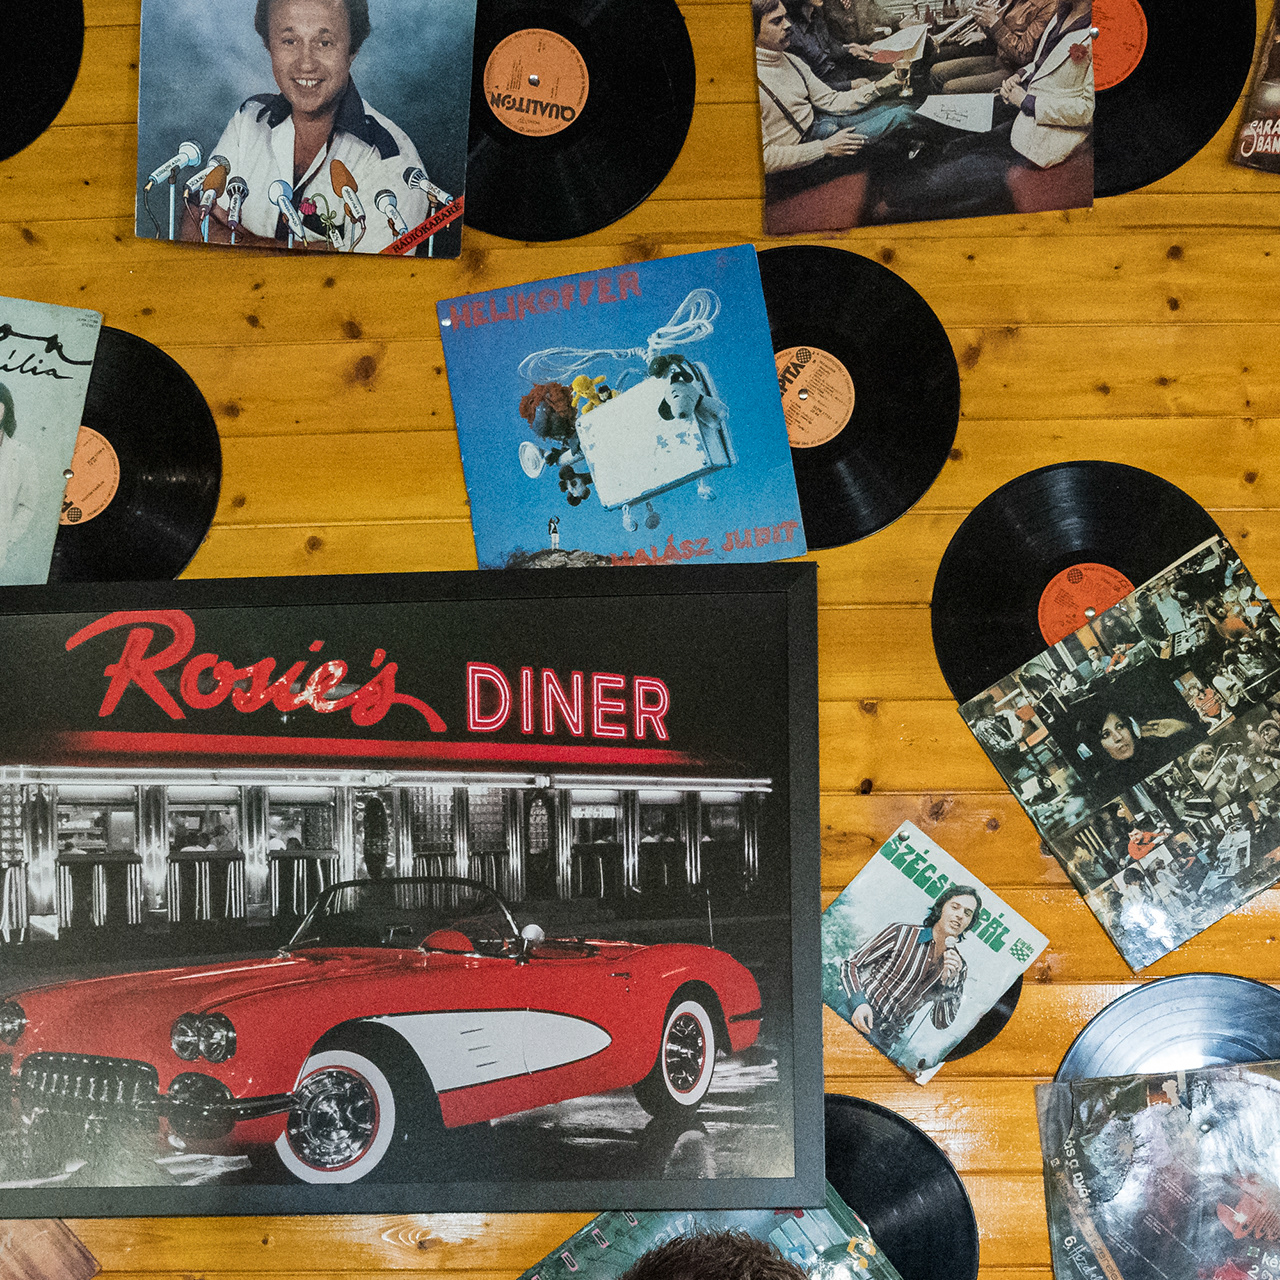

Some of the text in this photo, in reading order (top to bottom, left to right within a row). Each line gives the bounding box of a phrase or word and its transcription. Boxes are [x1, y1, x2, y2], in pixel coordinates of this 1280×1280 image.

[490, 91, 576, 122] QUALITON
[449, 270, 642, 333] HELIKOFFER
[721, 519, 799, 552] JUDIT
[65, 610, 670, 741] Rosie's DINER
[880, 836, 1011, 953] SZÉCS PÁL
